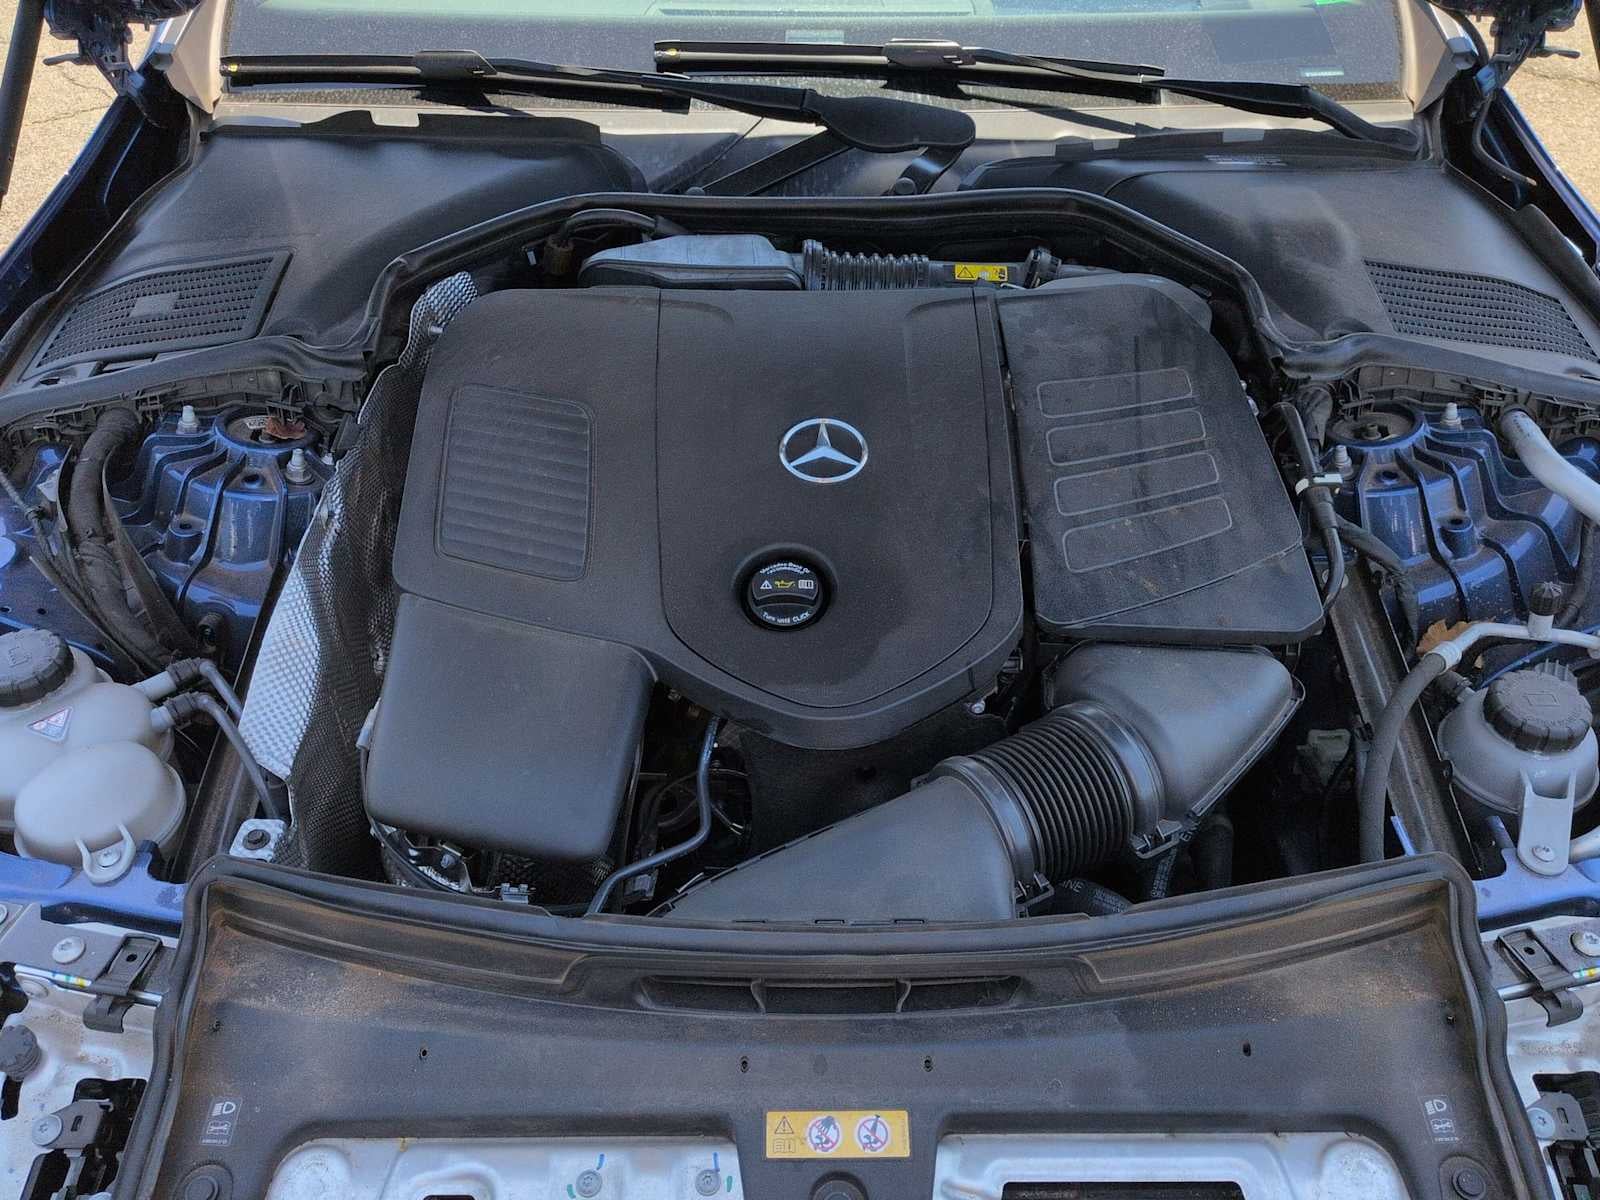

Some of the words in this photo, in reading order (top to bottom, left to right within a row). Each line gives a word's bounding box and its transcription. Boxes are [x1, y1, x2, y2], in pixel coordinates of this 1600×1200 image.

[763, 611, 775, 622] Turn
[777, 616, 790, 624] until
[792, 610, 809, 622] CLICK
